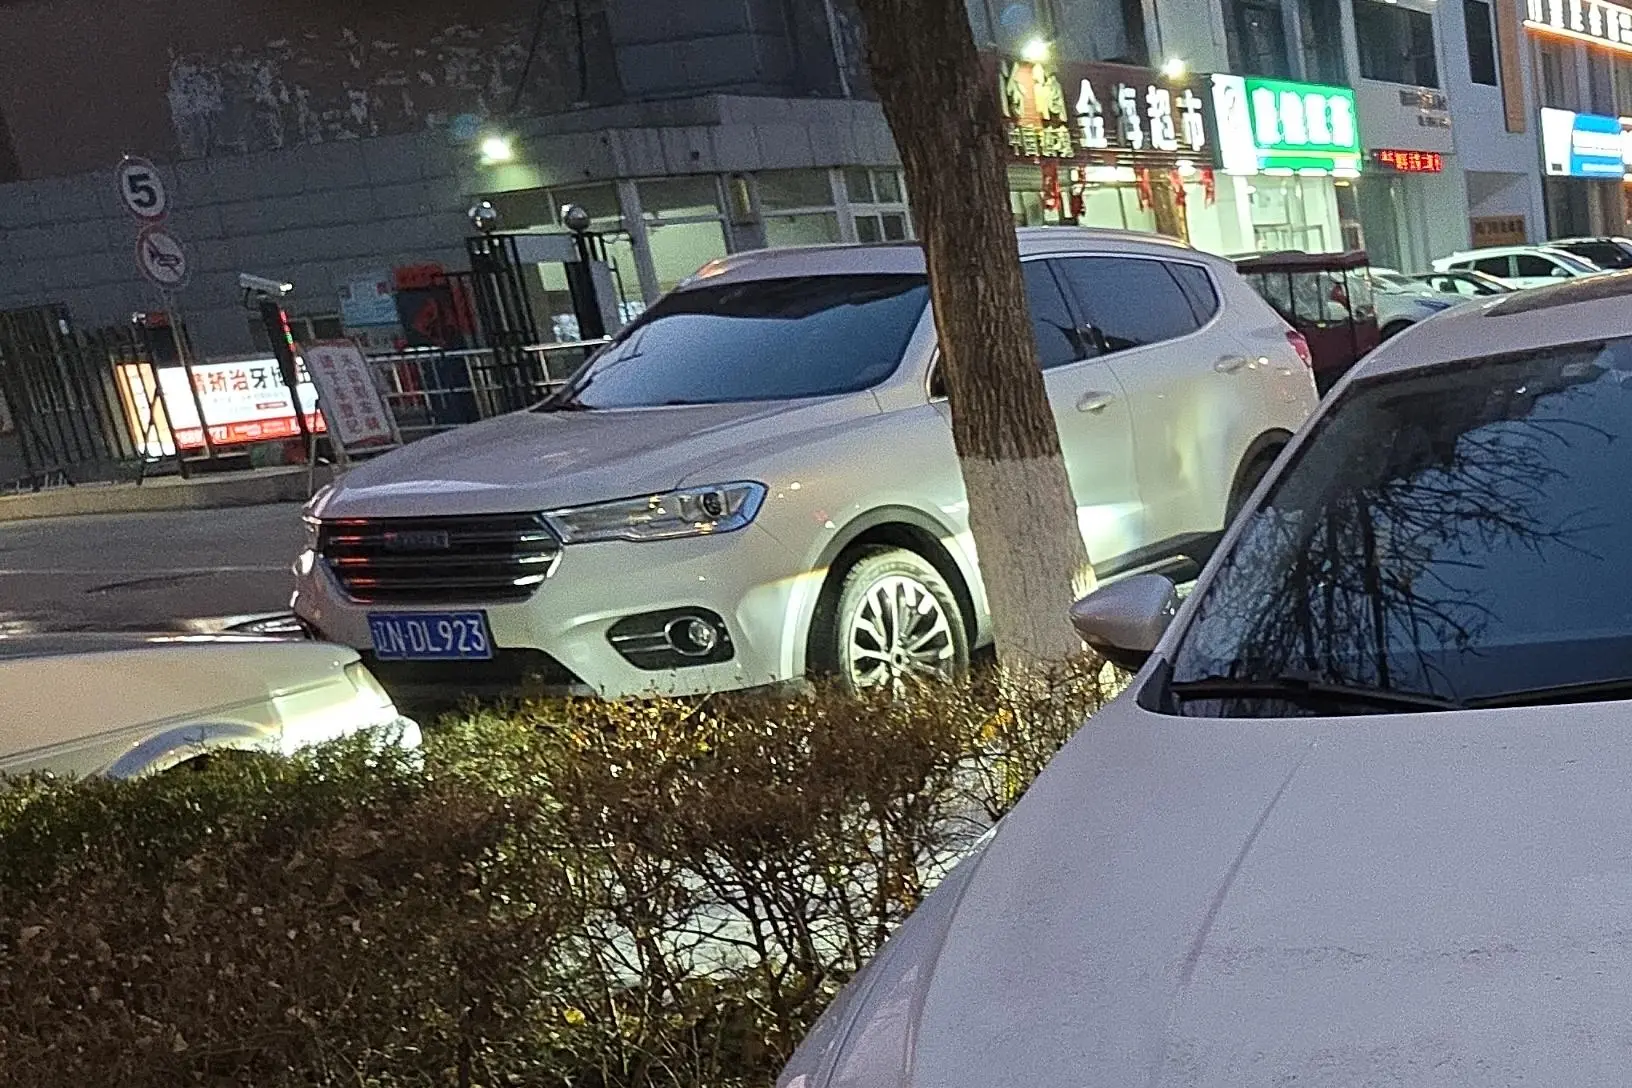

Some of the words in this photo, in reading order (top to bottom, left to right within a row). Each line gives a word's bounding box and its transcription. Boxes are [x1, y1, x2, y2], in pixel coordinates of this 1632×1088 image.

[1075, 78, 1205, 151] 金海超市
[128, 172, 157, 208] 5
